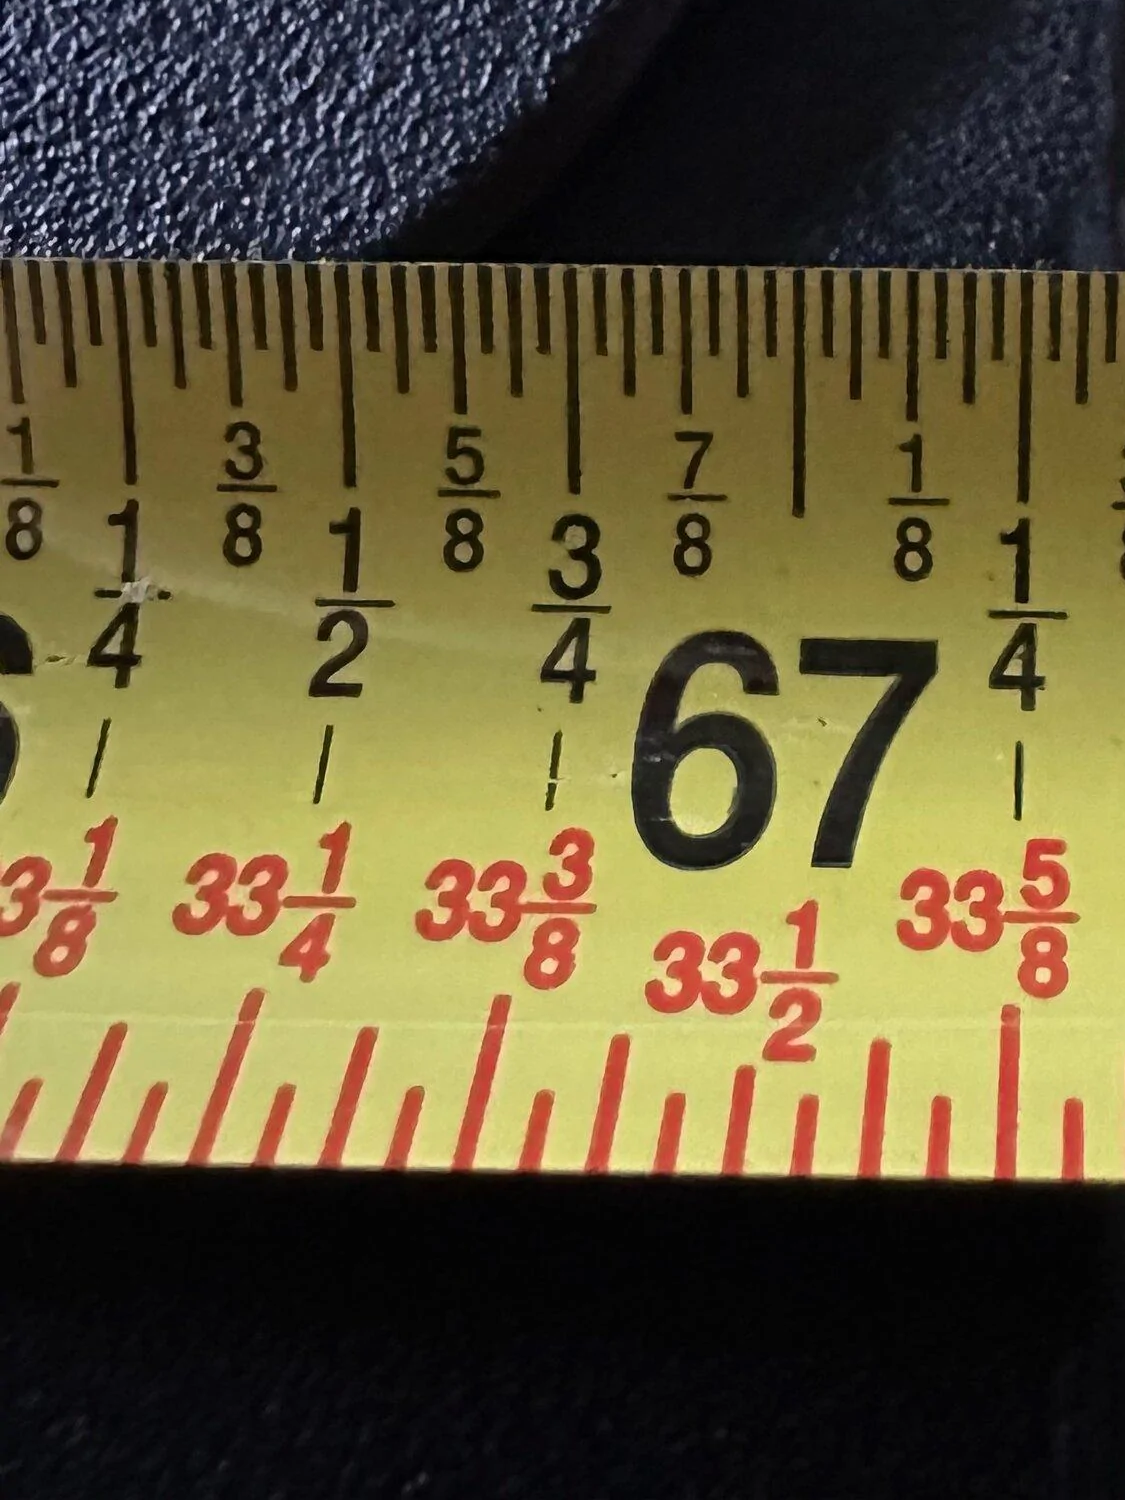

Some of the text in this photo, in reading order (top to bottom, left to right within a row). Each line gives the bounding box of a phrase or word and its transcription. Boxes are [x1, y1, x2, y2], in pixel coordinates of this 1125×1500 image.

[631, 631, 938, 870] 67
[173, 853, 289, 936] 33
[414, 859, 520, 943] 33
[896, 868, 1001, 952] 33
[645, 930, 762, 1015] 33
